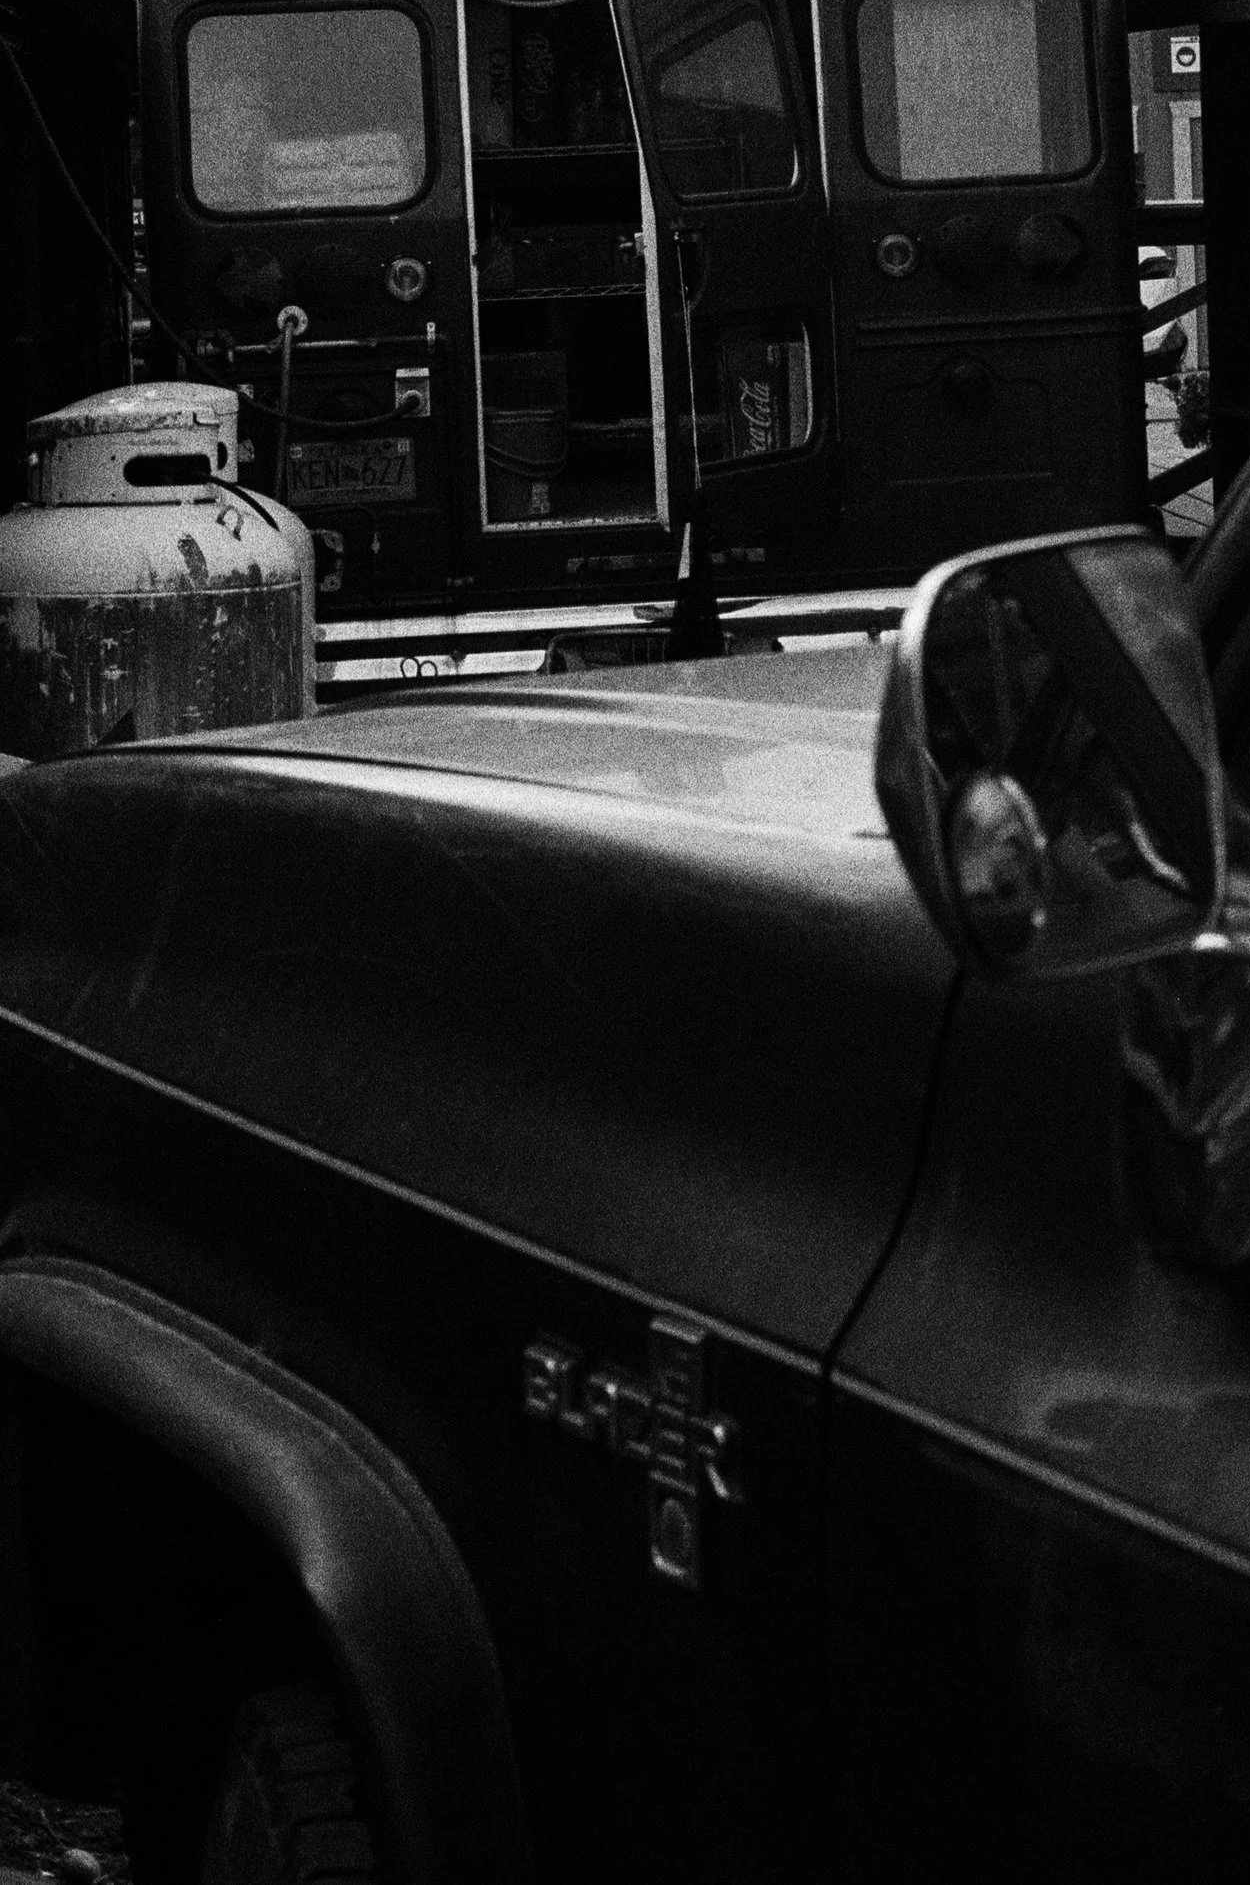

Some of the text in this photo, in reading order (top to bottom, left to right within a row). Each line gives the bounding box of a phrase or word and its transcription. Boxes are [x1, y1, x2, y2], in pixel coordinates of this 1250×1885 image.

[489, 47, 512, 106] Coke
[291, 455, 406, 490] KEN 627
